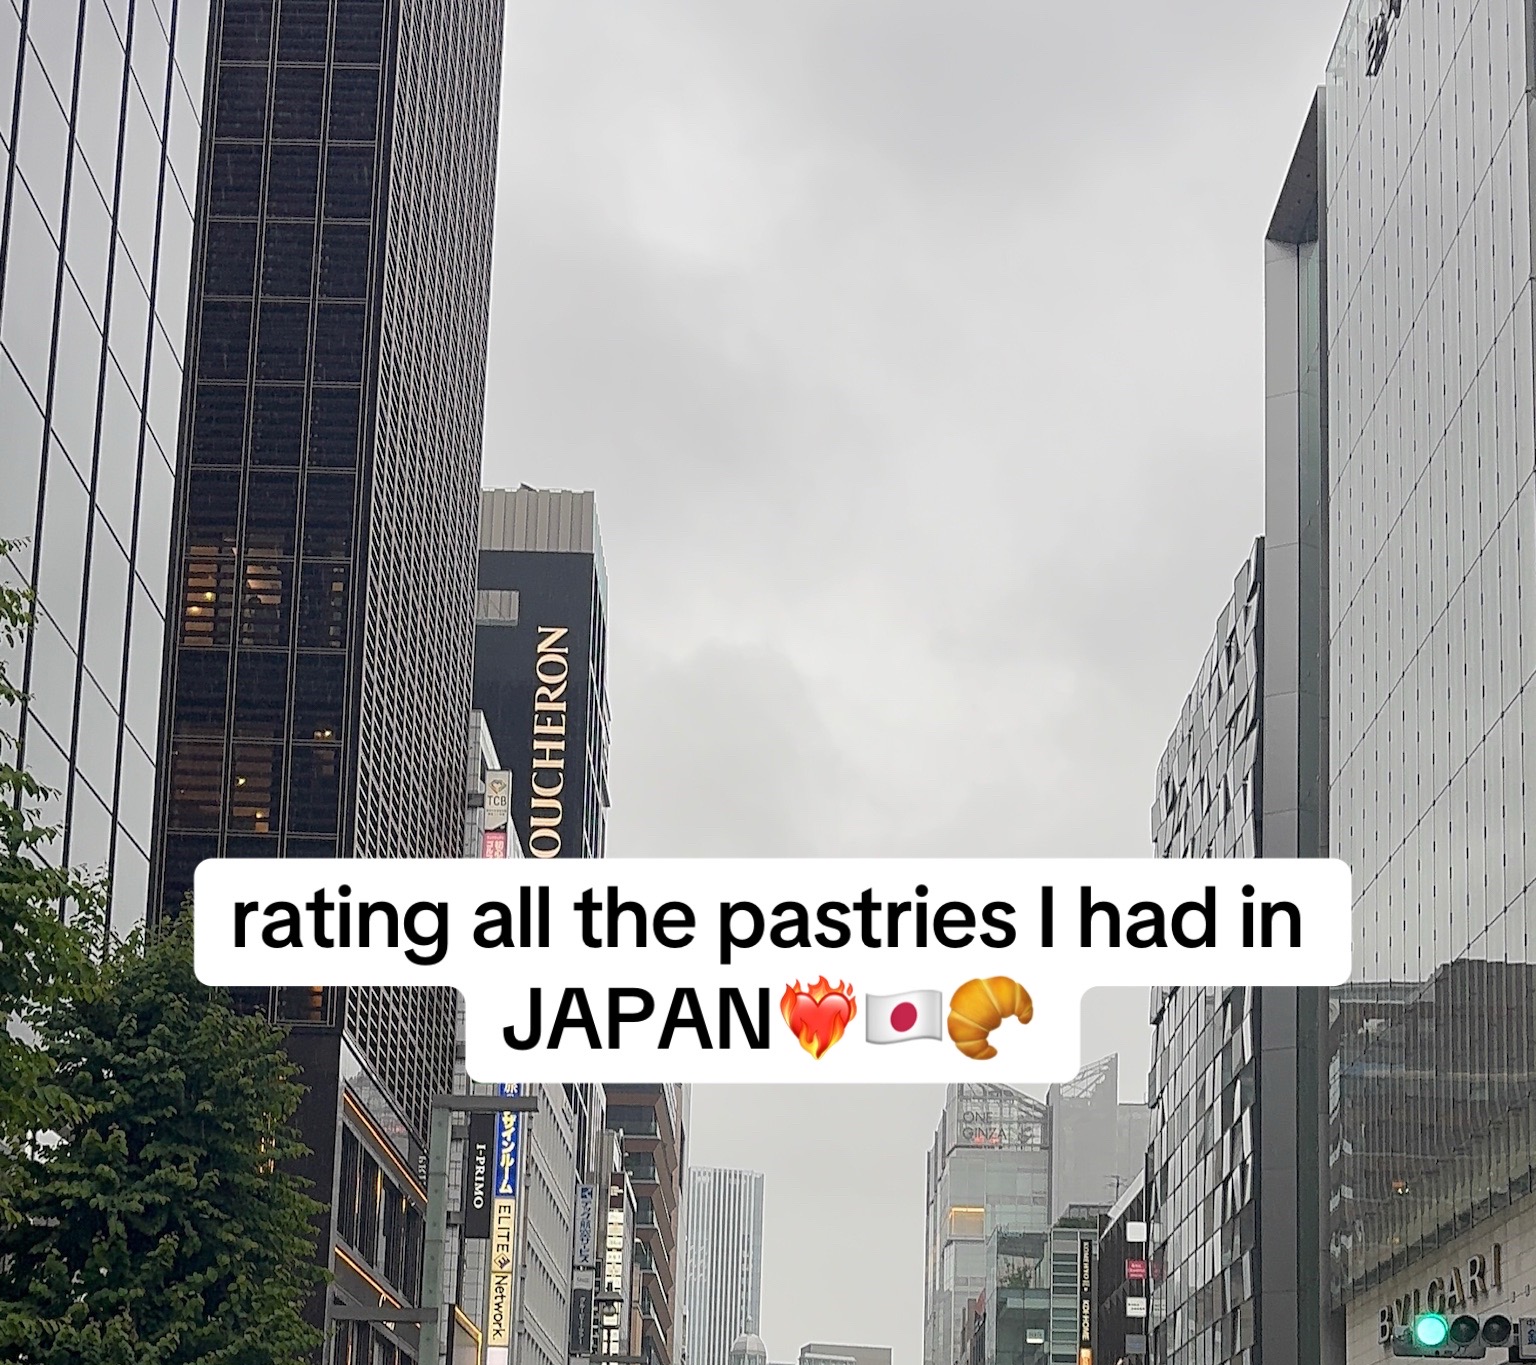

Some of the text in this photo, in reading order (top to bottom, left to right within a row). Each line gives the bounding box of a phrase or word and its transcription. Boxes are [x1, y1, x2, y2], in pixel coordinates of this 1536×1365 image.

[528, 626, 569, 858] OUCHERON
[487, 795, 507, 806] TCB
[963, 1111, 993, 1123] ONE
[962, 1126, 1008, 1140] GINZA
[473, 1143, 487, 1210] I-PRIMO
[496, 1204, 512, 1253] ELITE
